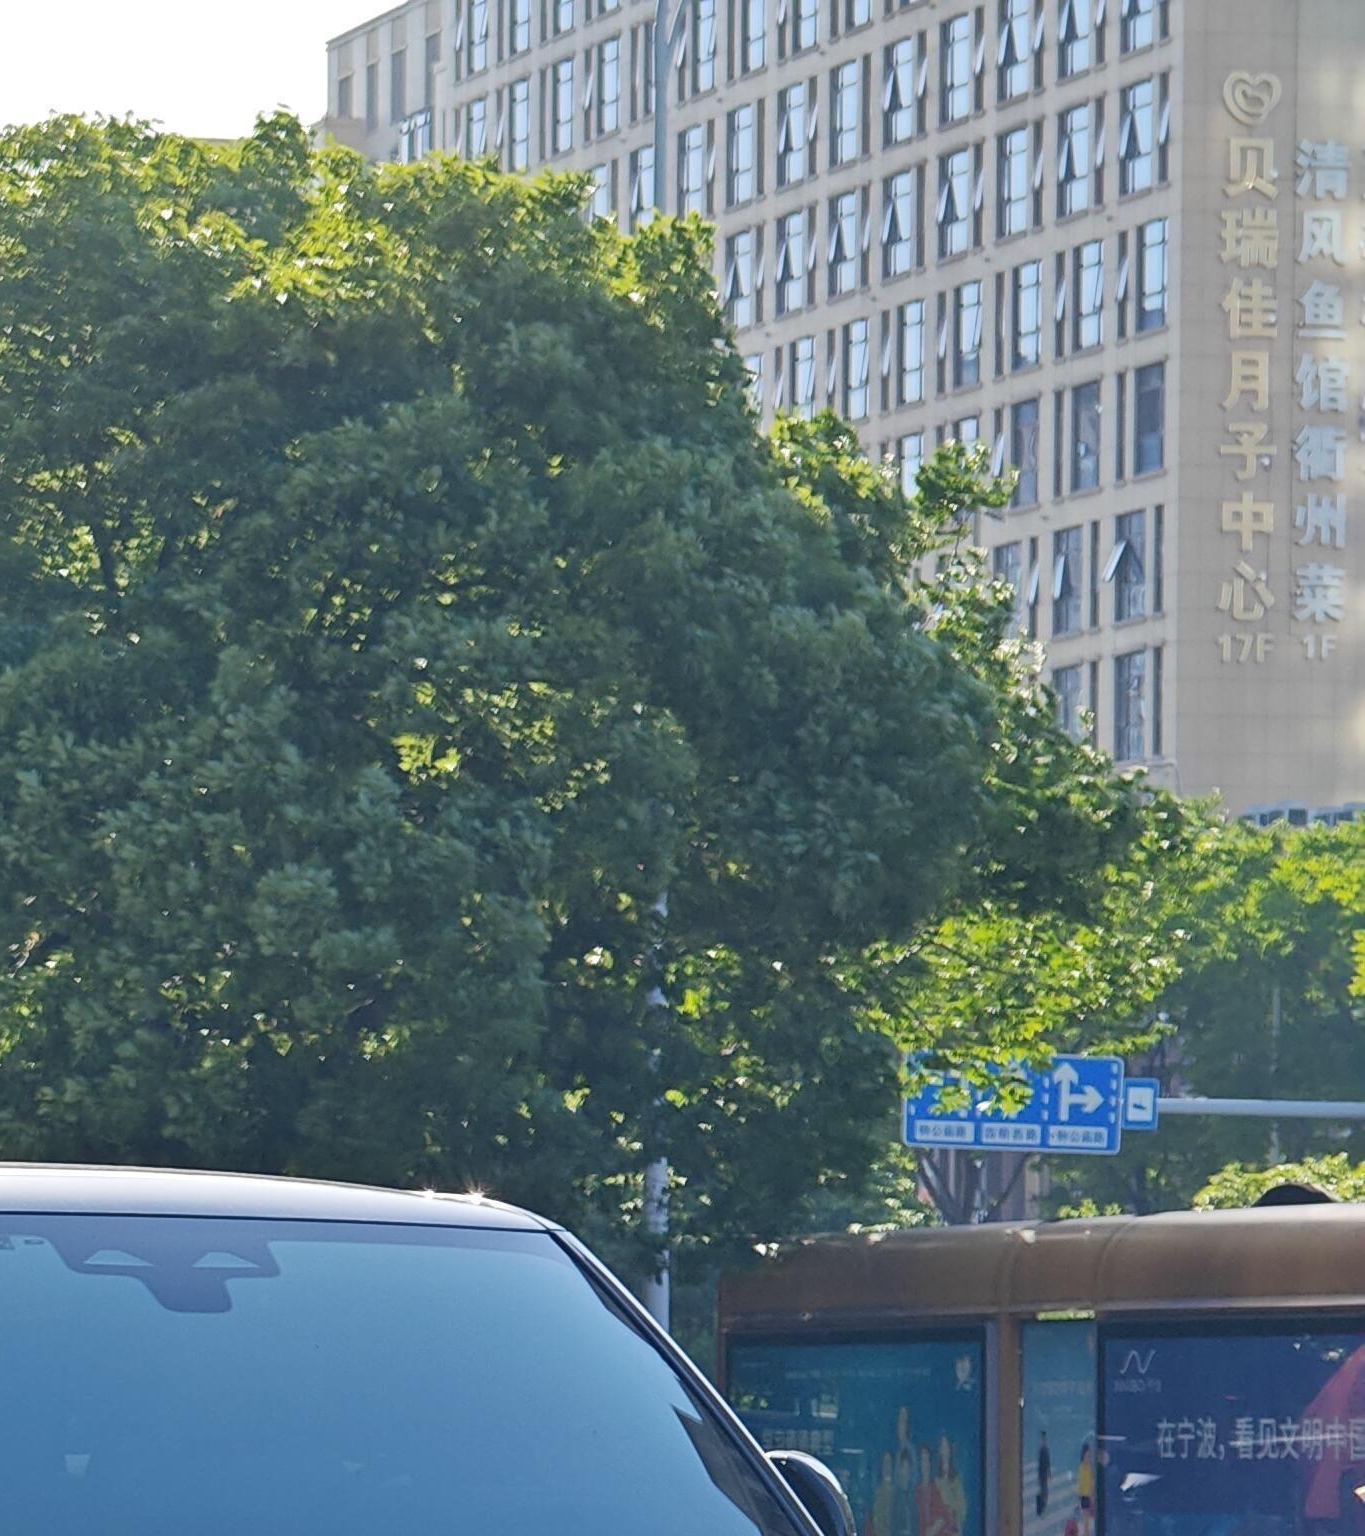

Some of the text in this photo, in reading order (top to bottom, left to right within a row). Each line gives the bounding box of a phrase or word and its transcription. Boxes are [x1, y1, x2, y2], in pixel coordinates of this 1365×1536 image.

[1220, 136, 1279, 621] 贝瑞佳月子中心
[1294, 137, 1351, 622] 清风鱼馆衢州菜
[1219, 632, 1274, 662] 17F
[1302, 633, 1337, 660] 1F
